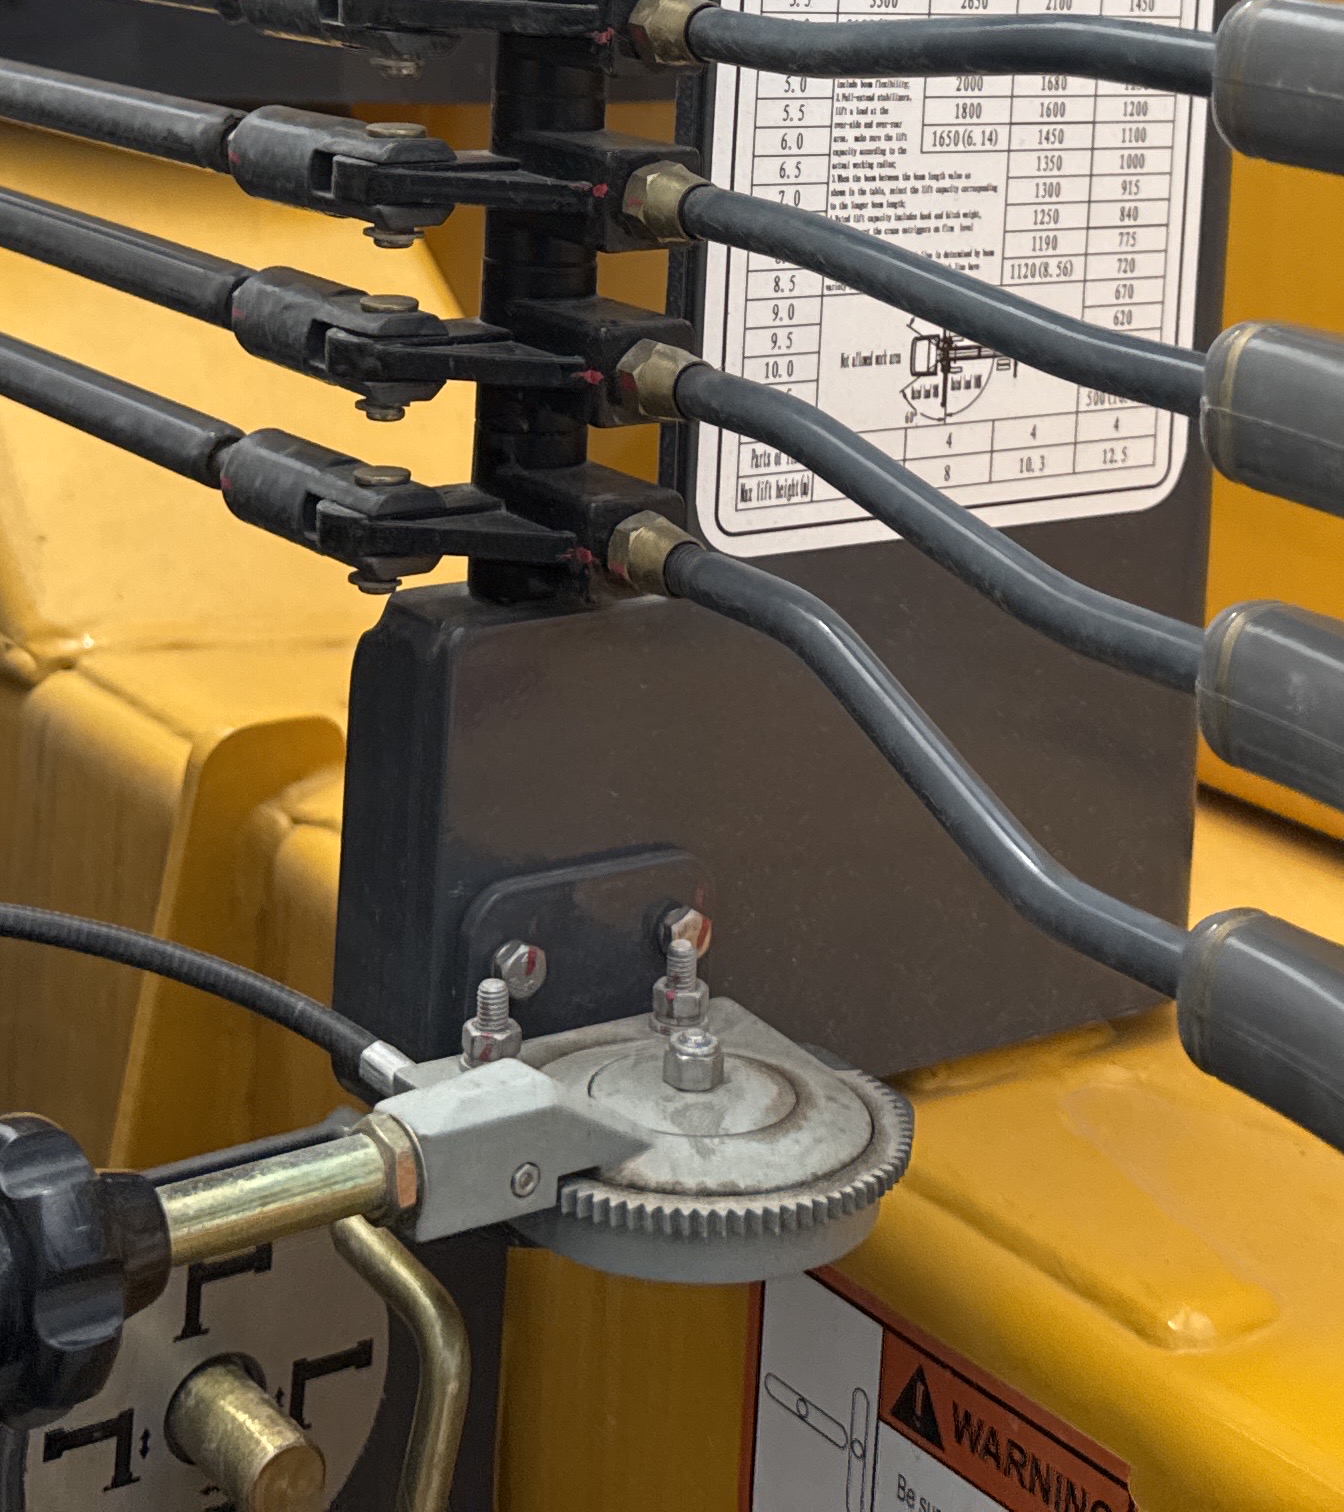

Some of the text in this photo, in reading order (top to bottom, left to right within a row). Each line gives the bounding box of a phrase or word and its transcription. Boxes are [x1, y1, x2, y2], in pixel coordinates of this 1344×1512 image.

[784, 75, 807, 93] 5.0
[955, 76, 984, 92] 2000
[782, 100, 1149, 122] 5.5 1800 1600 1200
[780, 132, 804, 151] 6.0
[931, 128, 999, 149] 1650(6.14)
[1038, 128, 1064, 145] 1450
[779, 153, 1145, 179] 6.5 1350 1000
[1035, 182, 1061, 199] 1300
[1121, 179, 1140, 196] 915
[1033, 205, 1139, 225] 1250 840
[1031, 231, 1137, 252] 1190 775
[1010, 258, 1136, 280] 1120(8.56) 720
[773, 275, 1134, 301] 8.5 670
[772, 303, 1133, 326] 9.0 620
[771, 332, 793, 350] 9.5
[764, 360, 794, 379] 10.0
[945, 432, 953, 449] 4
[1030, 423, 1037, 440] 4
[1113, 416, 1120, 432] 4
[944, 465, 951, 481] 8
[1019, 455, 1046, 474] 10.3
[1102, 446, 1128, 465] 12.5
[952, 1400, 1113, 1512] WARNIN
[897, 1473, 915, 1509] Be
